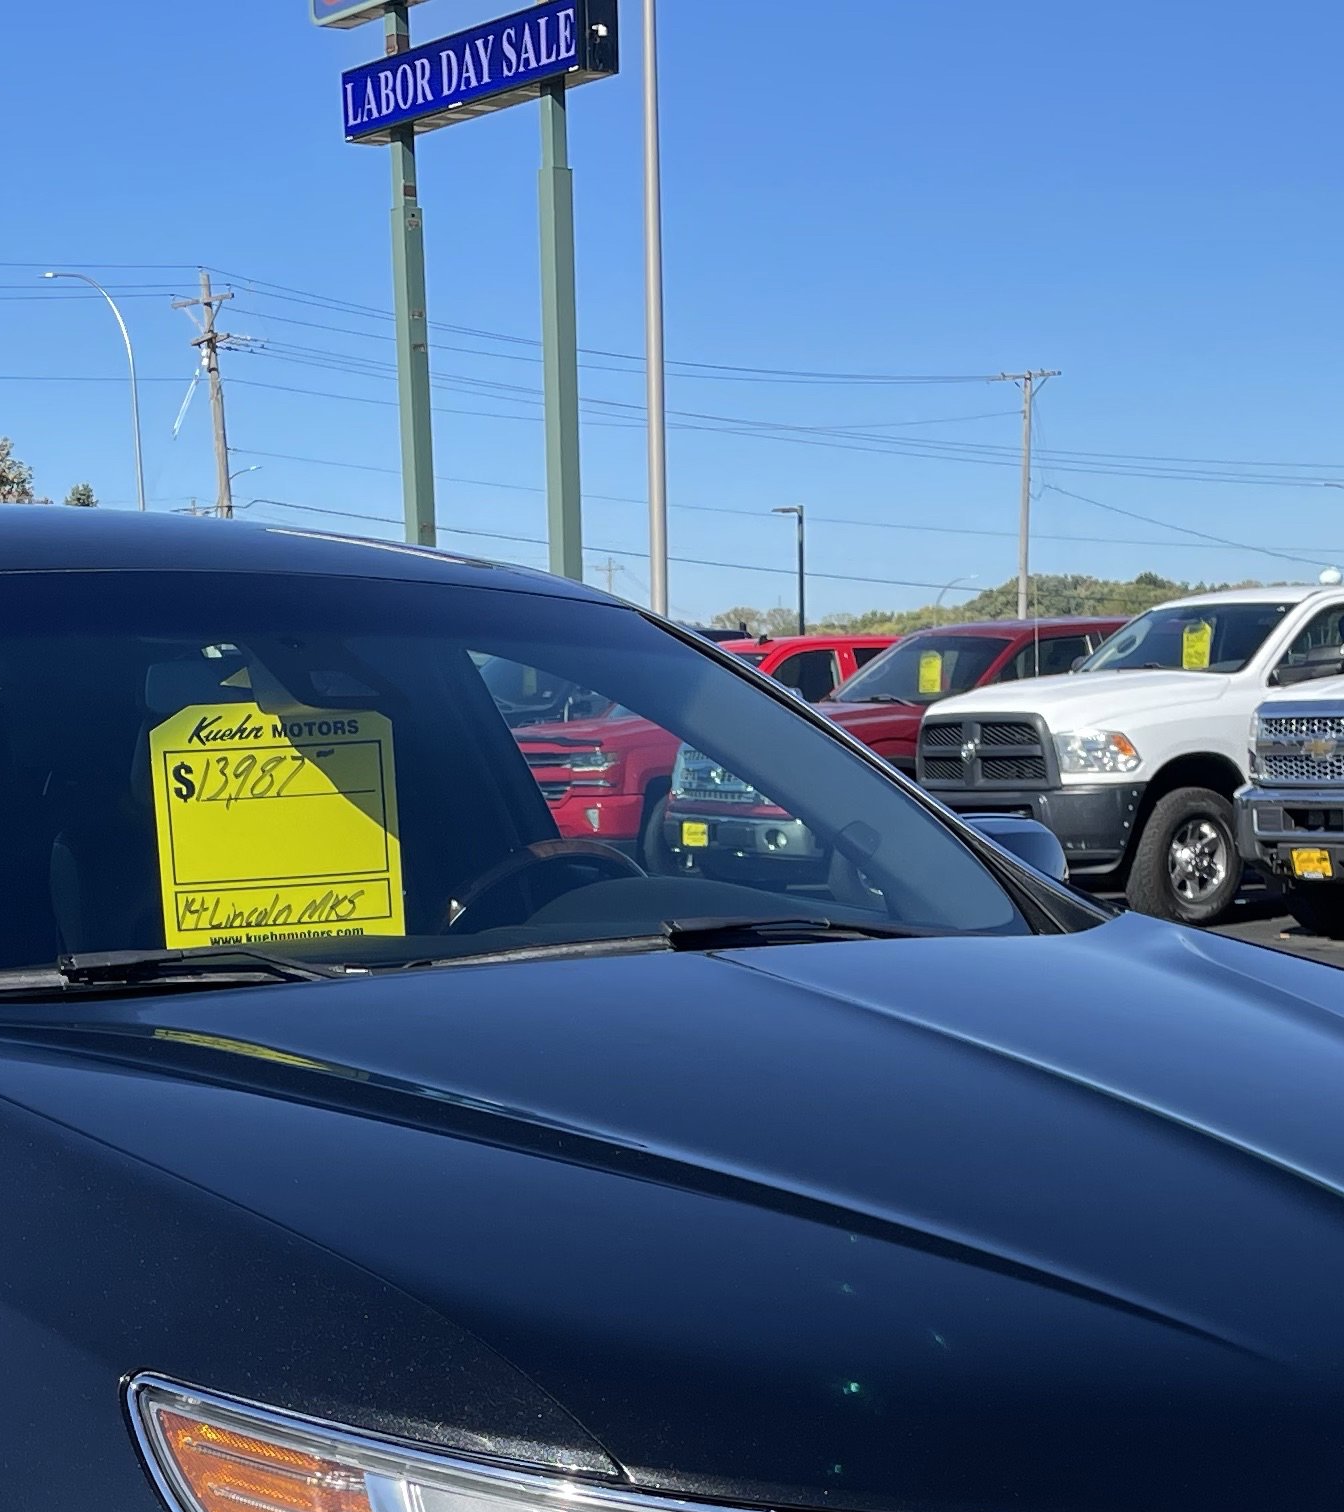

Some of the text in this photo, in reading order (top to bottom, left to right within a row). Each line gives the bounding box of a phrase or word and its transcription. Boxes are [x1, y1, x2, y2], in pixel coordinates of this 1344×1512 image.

[345, 8, 576, 127] LABOR DAY SALE
[187, 713, 360, 747] Kuehn MOTORS
[298, 889, 366, 922] MKS
